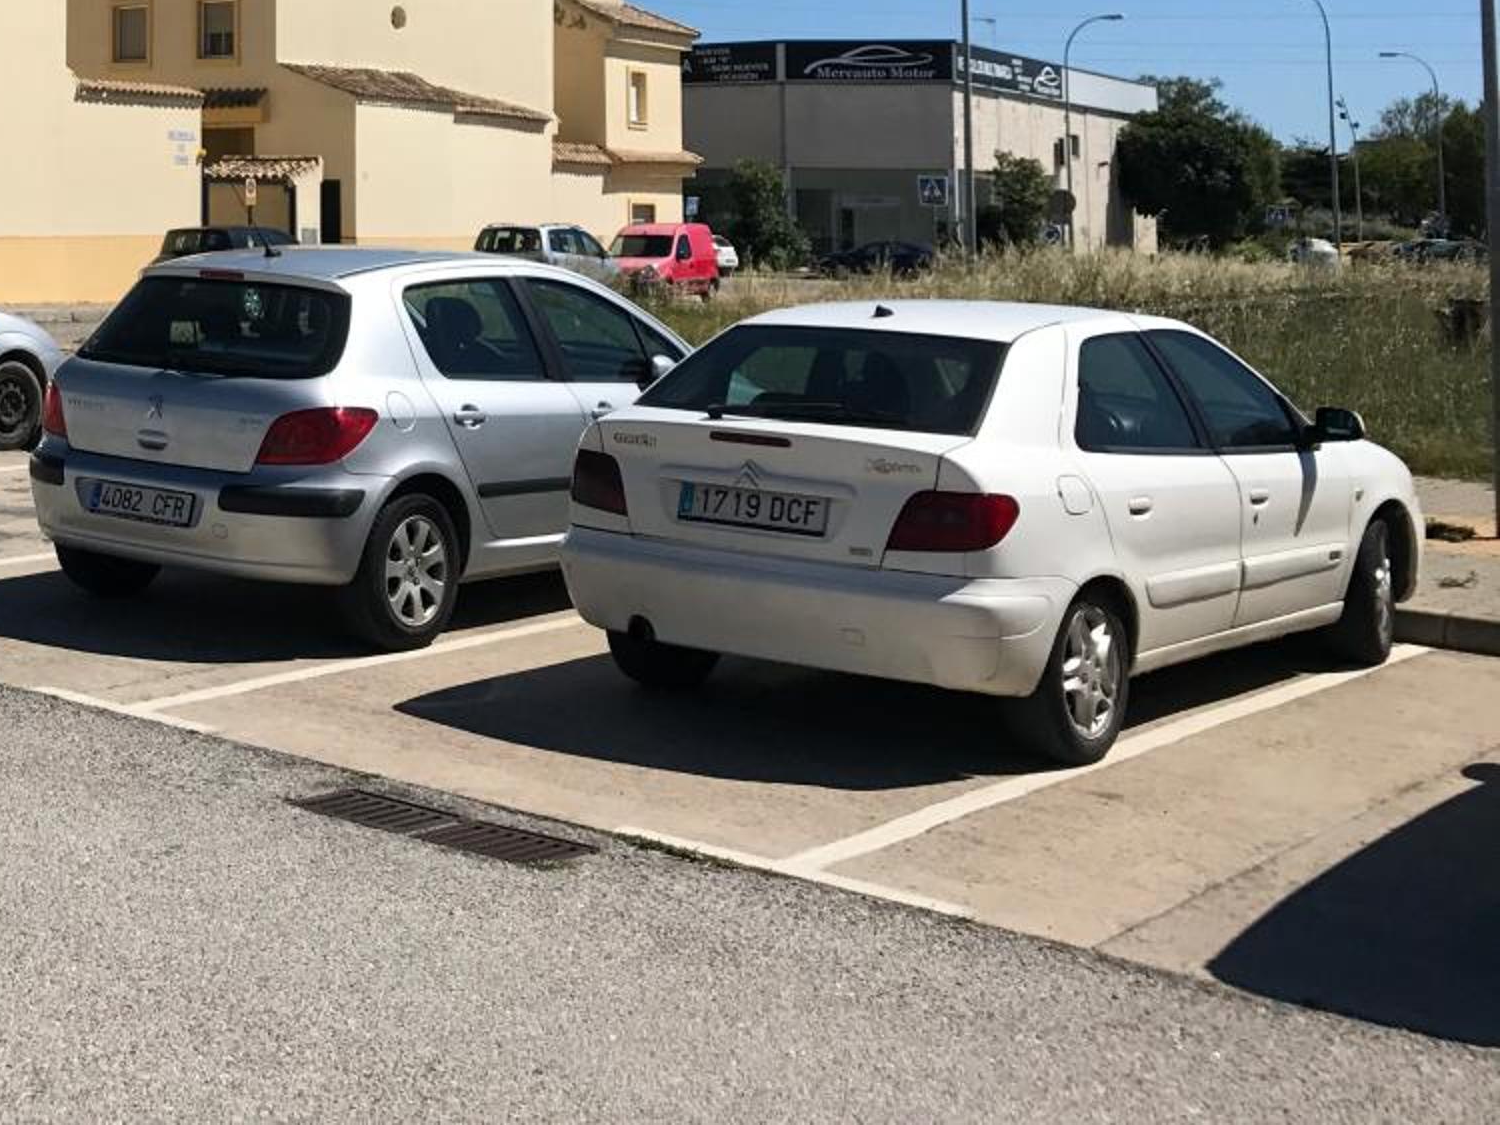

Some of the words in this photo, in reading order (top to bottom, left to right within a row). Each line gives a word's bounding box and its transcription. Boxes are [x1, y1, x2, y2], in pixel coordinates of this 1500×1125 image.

[817, 66, 887, 78] Mercauto
[890, 67, 935, 78] Motor
[101, 486, 143, 512] 4082
[153, 493, 185, 518] CFR
[701, 488, 761, 518] 1719
[769, 496, 821, 525] DCF
